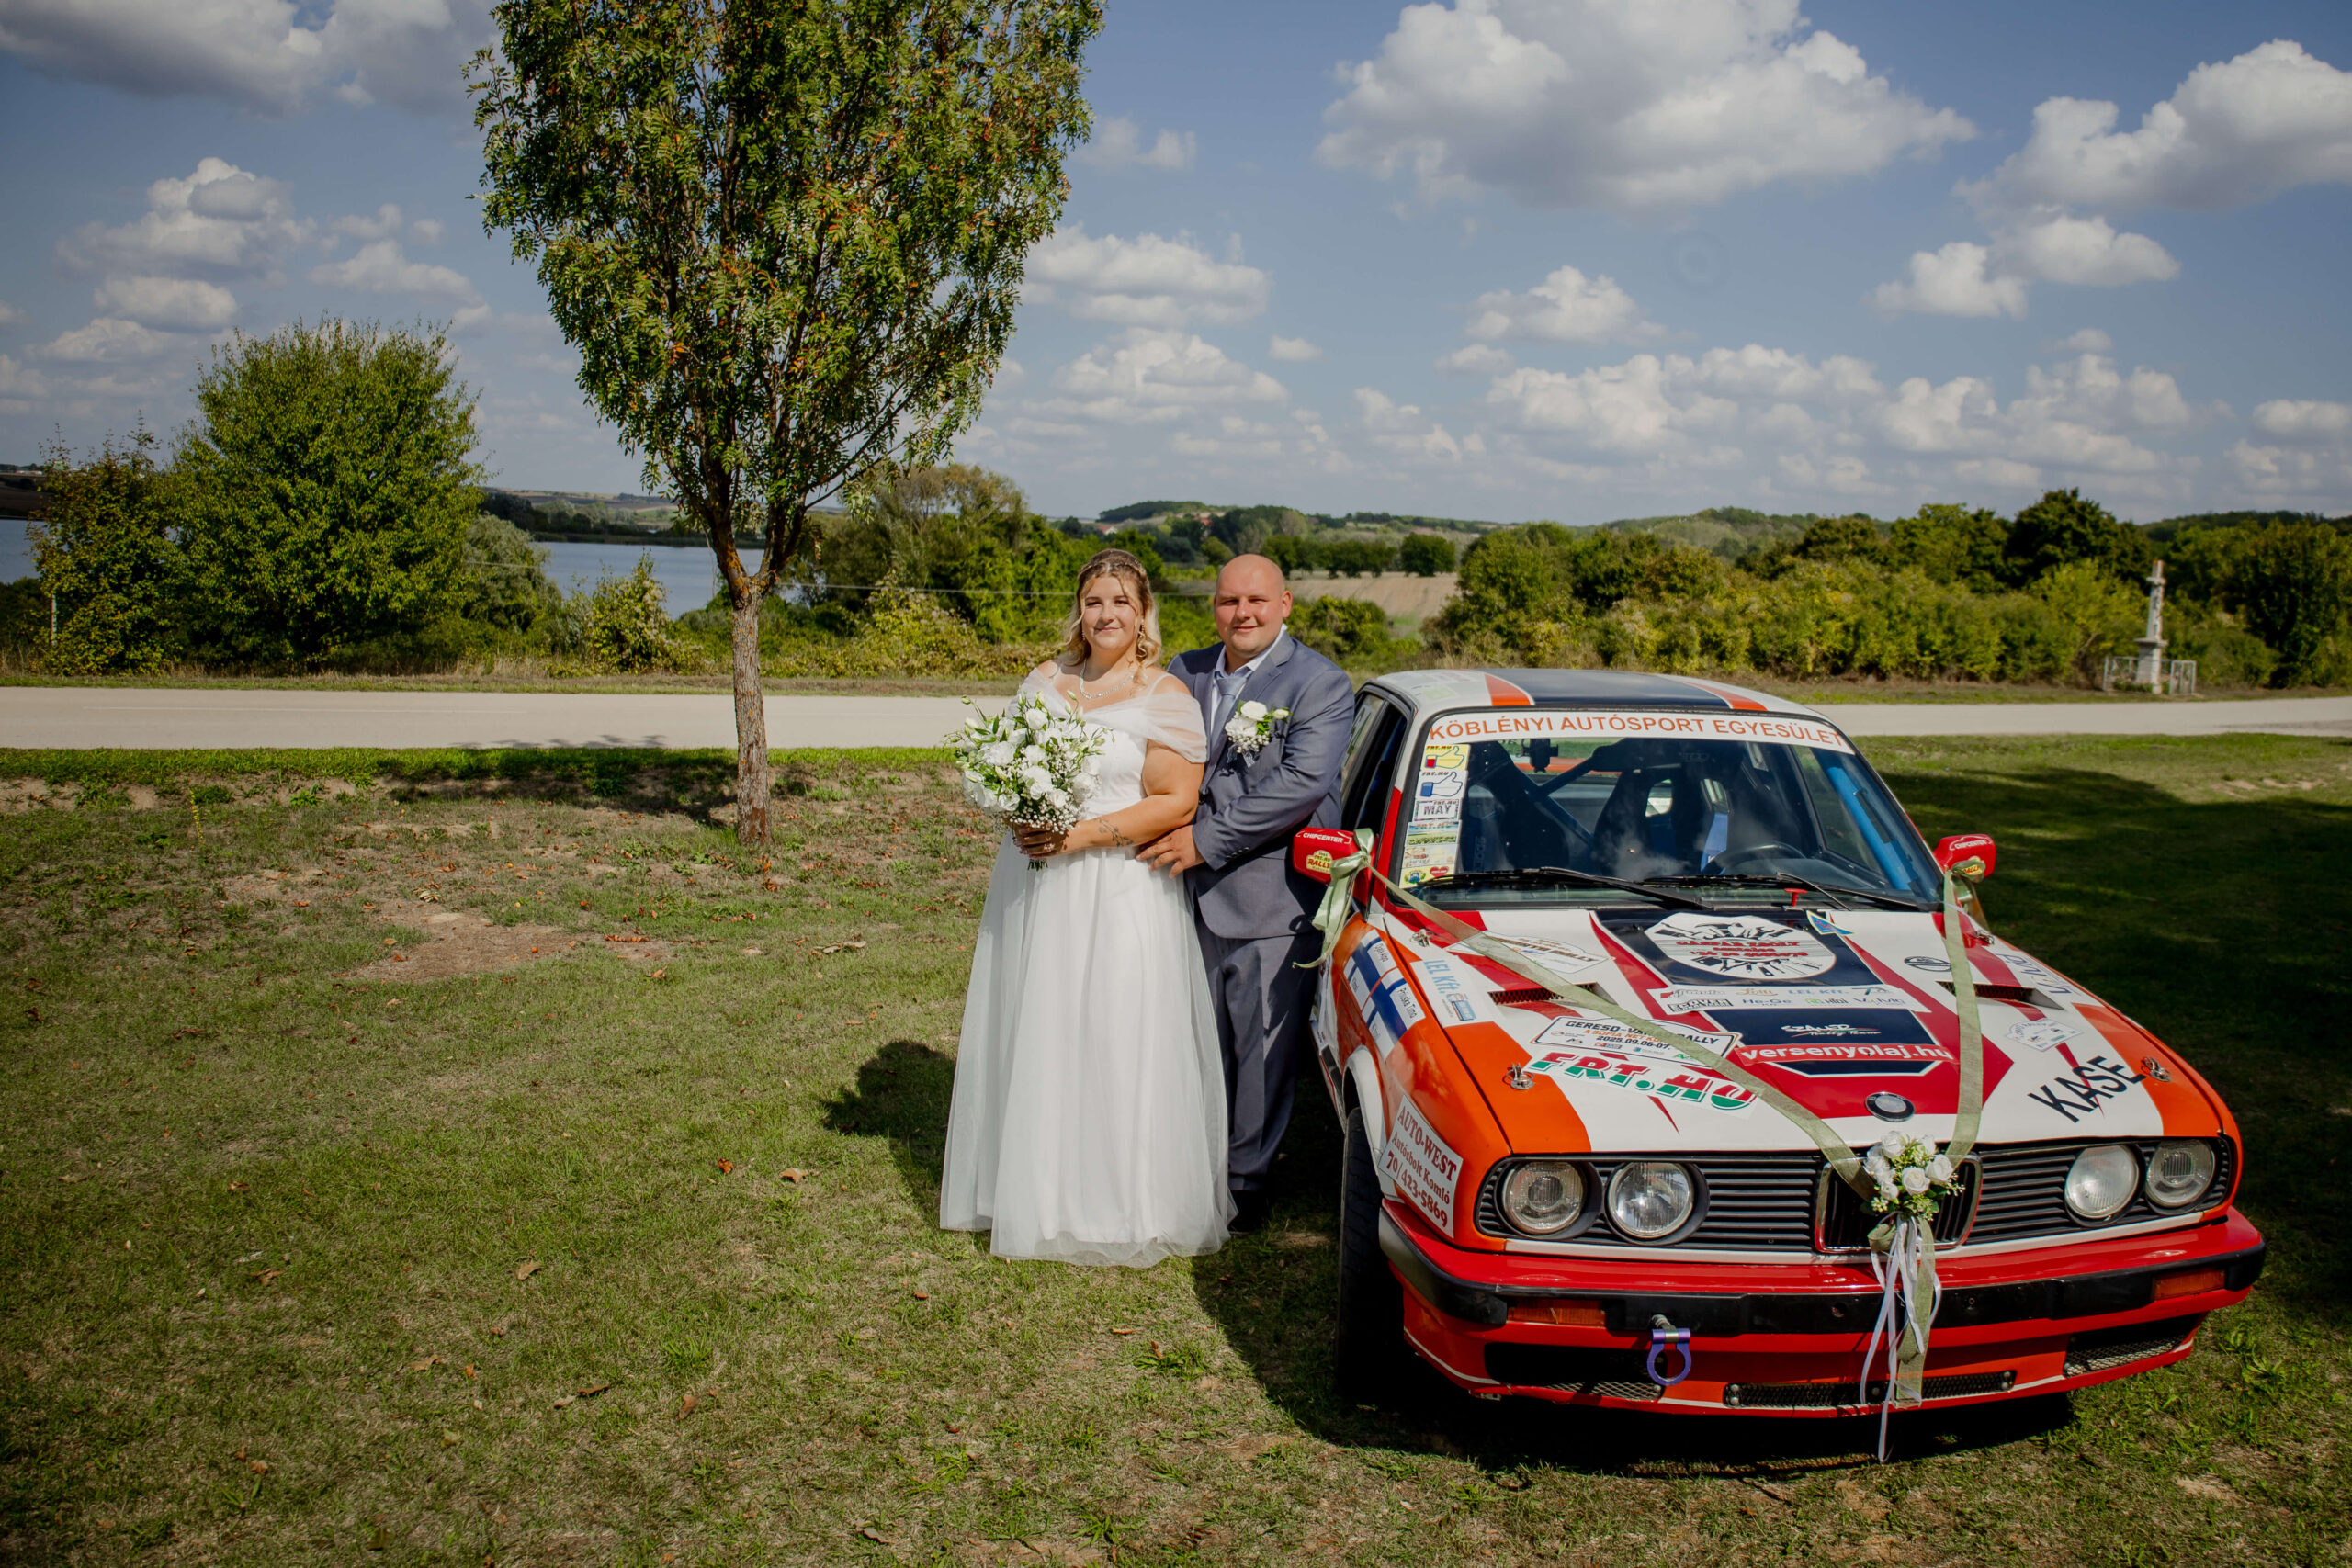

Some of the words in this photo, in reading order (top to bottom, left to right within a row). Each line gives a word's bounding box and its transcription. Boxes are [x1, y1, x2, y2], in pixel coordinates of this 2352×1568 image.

[1430, 716, 1553, 740] KÖBLÉNYI
[1561, 714, 1704, 733] AUTÓSPORT
[1713, 719, 1843, 746] EGYESÜLET
[1424, 805, 1452, 816] MAY
[1303, 832, 1343, 844] CHIPCENTER
[1424, 960, 1451, 975] LEL
[1432, 976, 1461, 995] Kft.
[1741, 1044, 1954, 1061] versenyolaj.hu
[1529, 1052, 1757, 1110] FRT.HU
[2027, 1055, 2147, 1123] KASE
[1397, 1105, 1456, 1181] AUTO-WEST
[1392, 1131, 1423, 1178] Autósbolt
[1423, 1169, 1450, 1205] Komló
